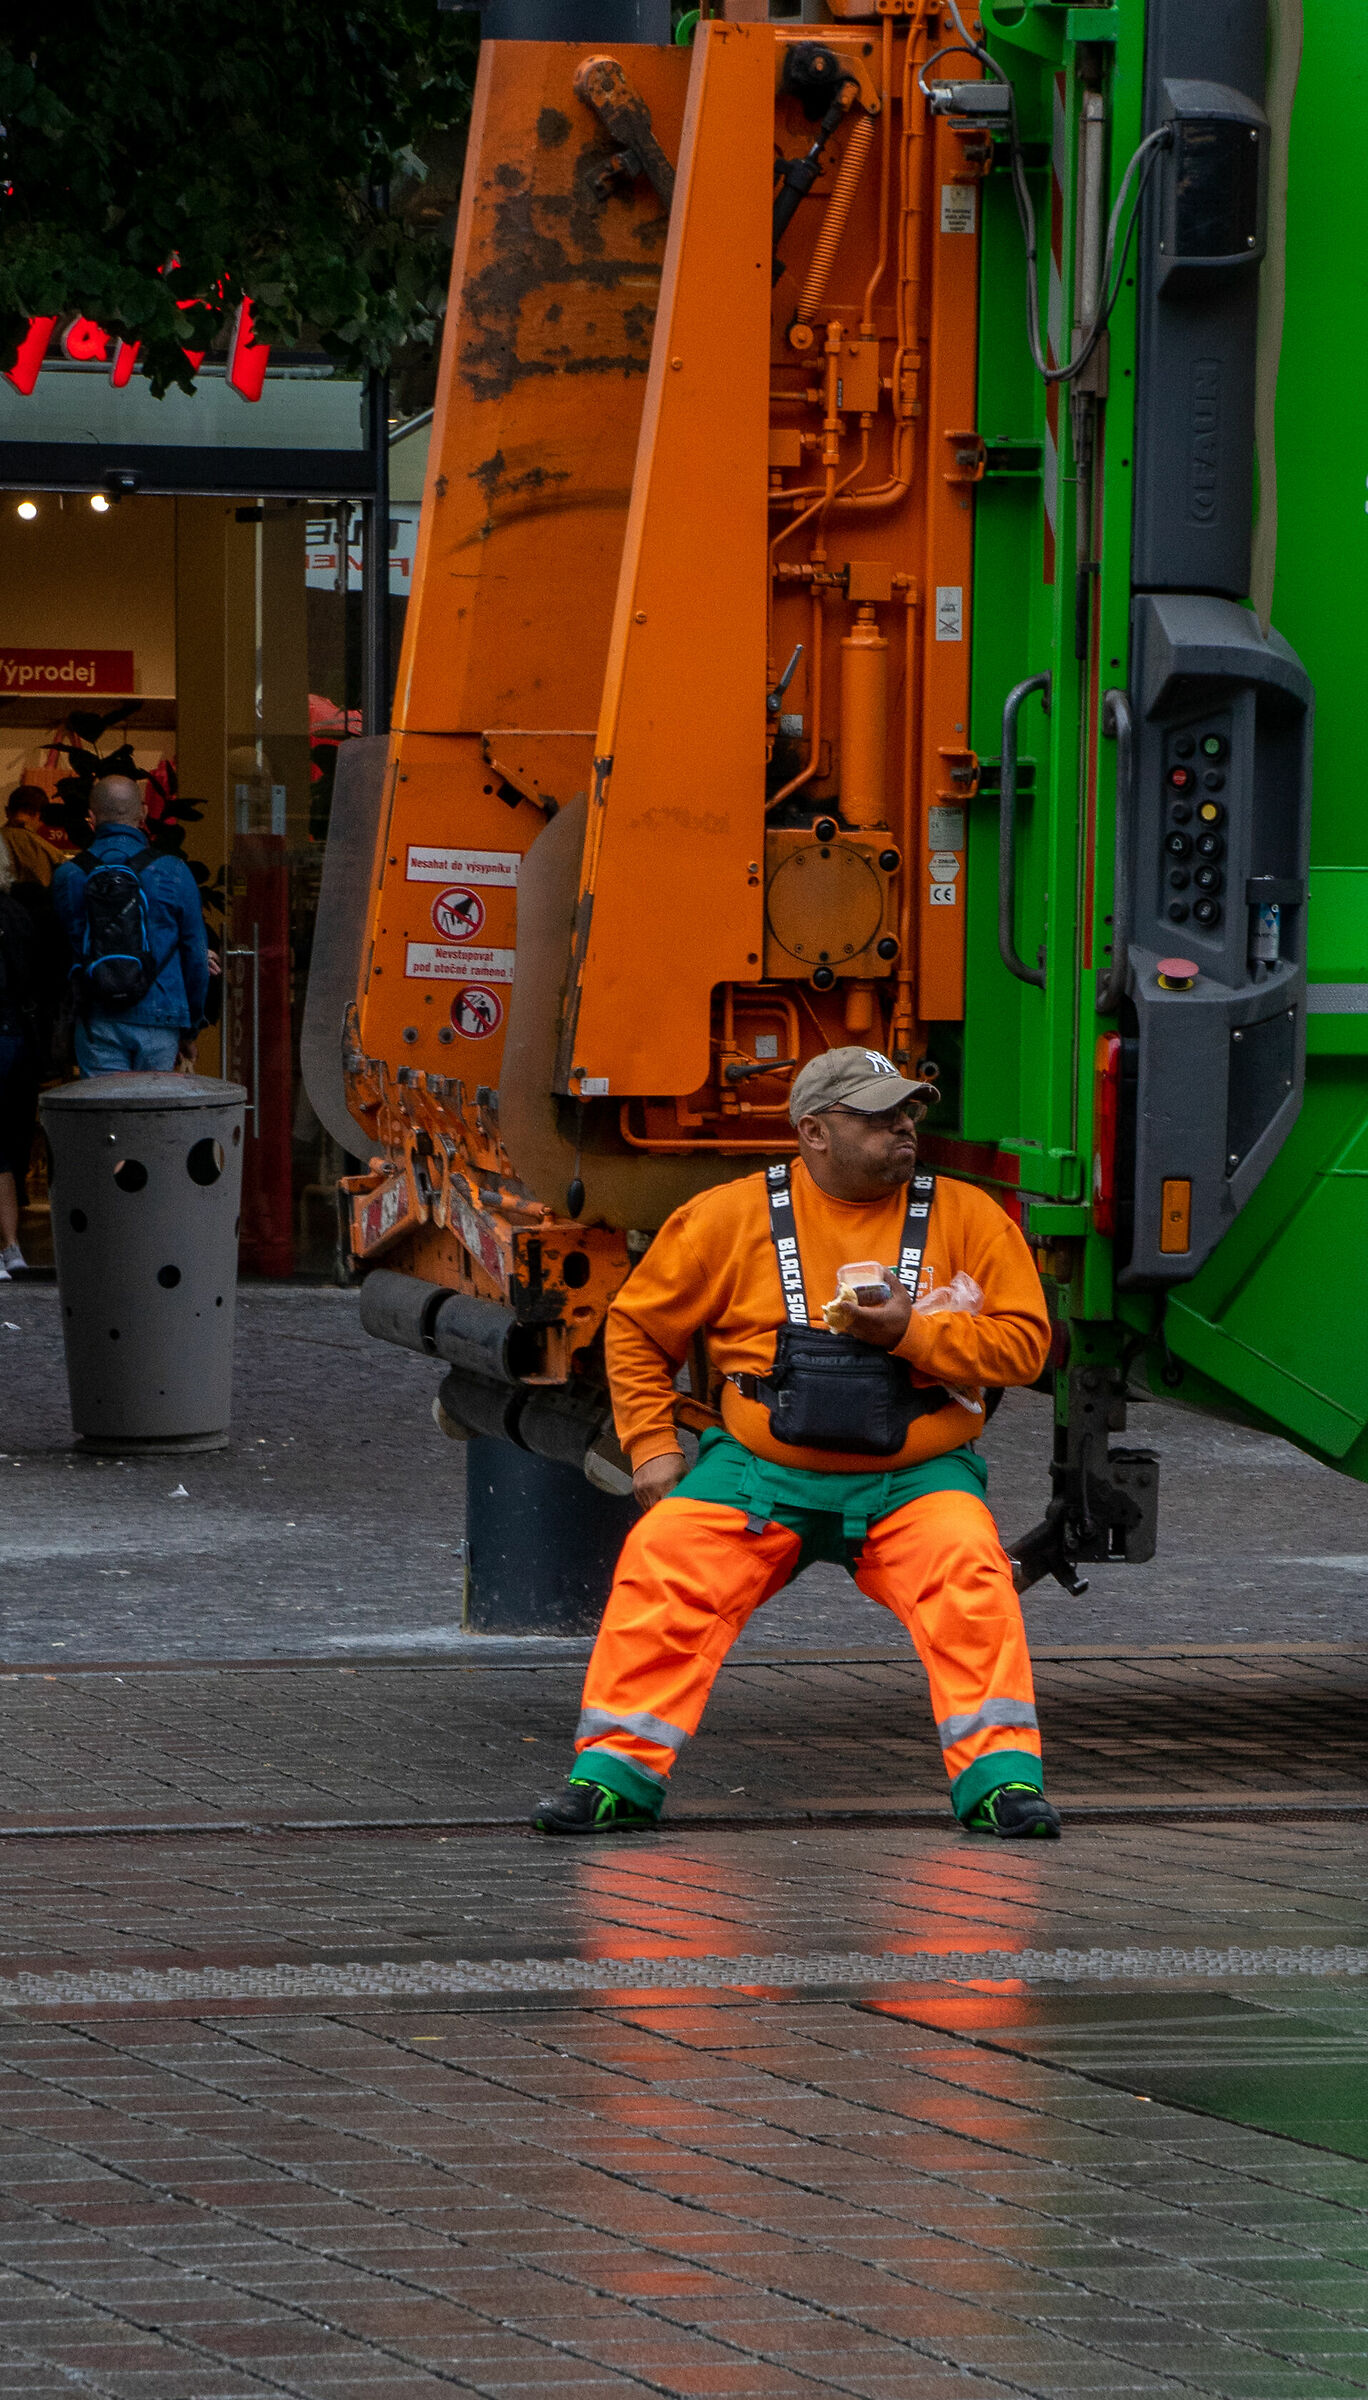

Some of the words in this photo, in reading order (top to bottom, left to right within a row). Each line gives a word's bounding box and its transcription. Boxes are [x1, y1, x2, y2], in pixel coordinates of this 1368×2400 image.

[452, 860, 463, 871] do
[934, 888, 951, 901] CE
[435, 948, 494, 962] Nevstupovat
[413, 962, 431, 973] pod
[471, 966, 506, 977] rameno
[778, 1237, 803, 1290] BLACK
[900, 1247, 921, 1302] BLAC
[786, 1293, 809, 1326] SQU
